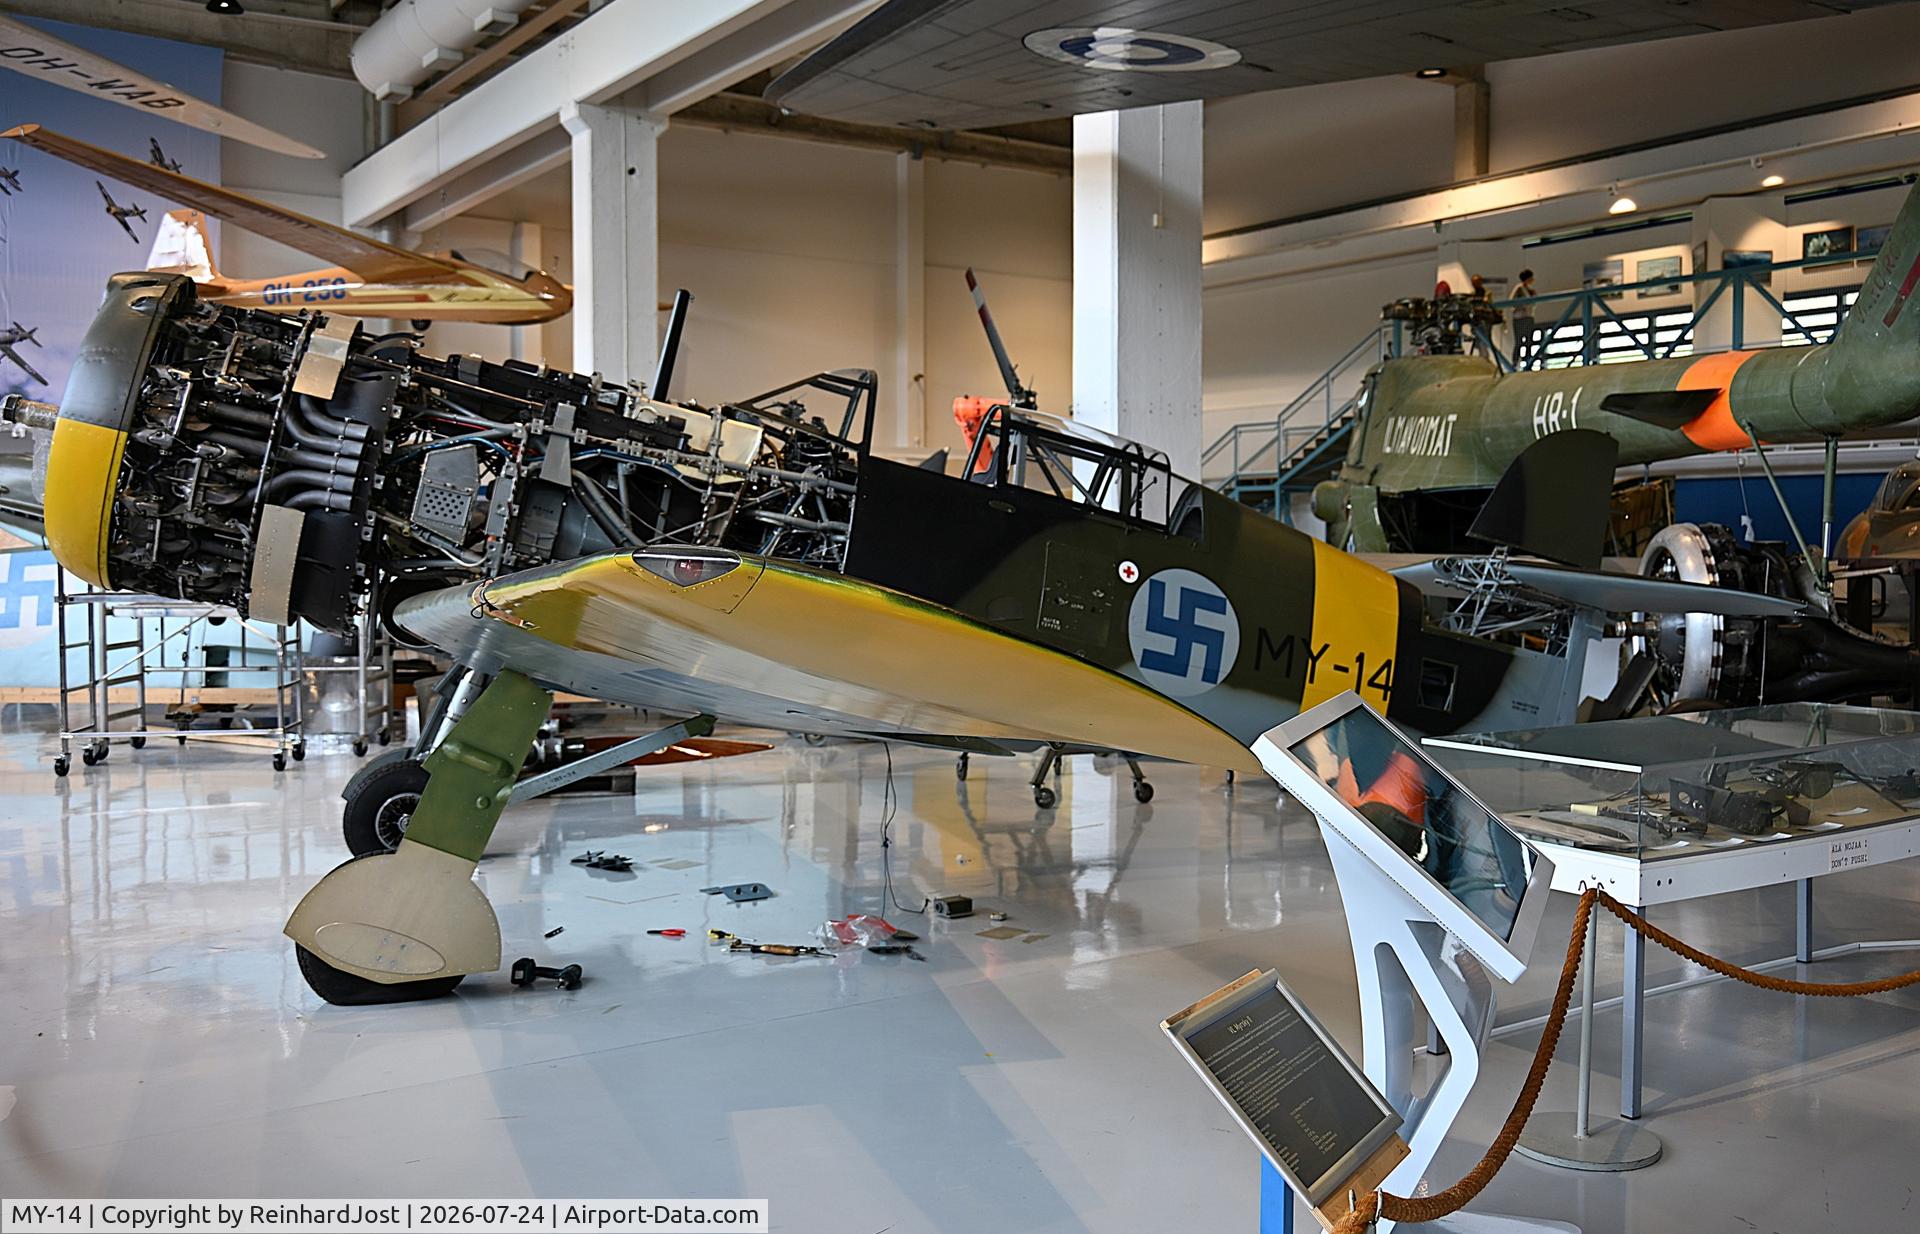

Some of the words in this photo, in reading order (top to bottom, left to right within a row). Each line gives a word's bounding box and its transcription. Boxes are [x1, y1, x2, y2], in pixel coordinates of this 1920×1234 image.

[0, 47, 186, 109] OH-WAB
[1254, 627, 1394, 702] MY-14
[1831, 857, 1849, 868] DON'T
